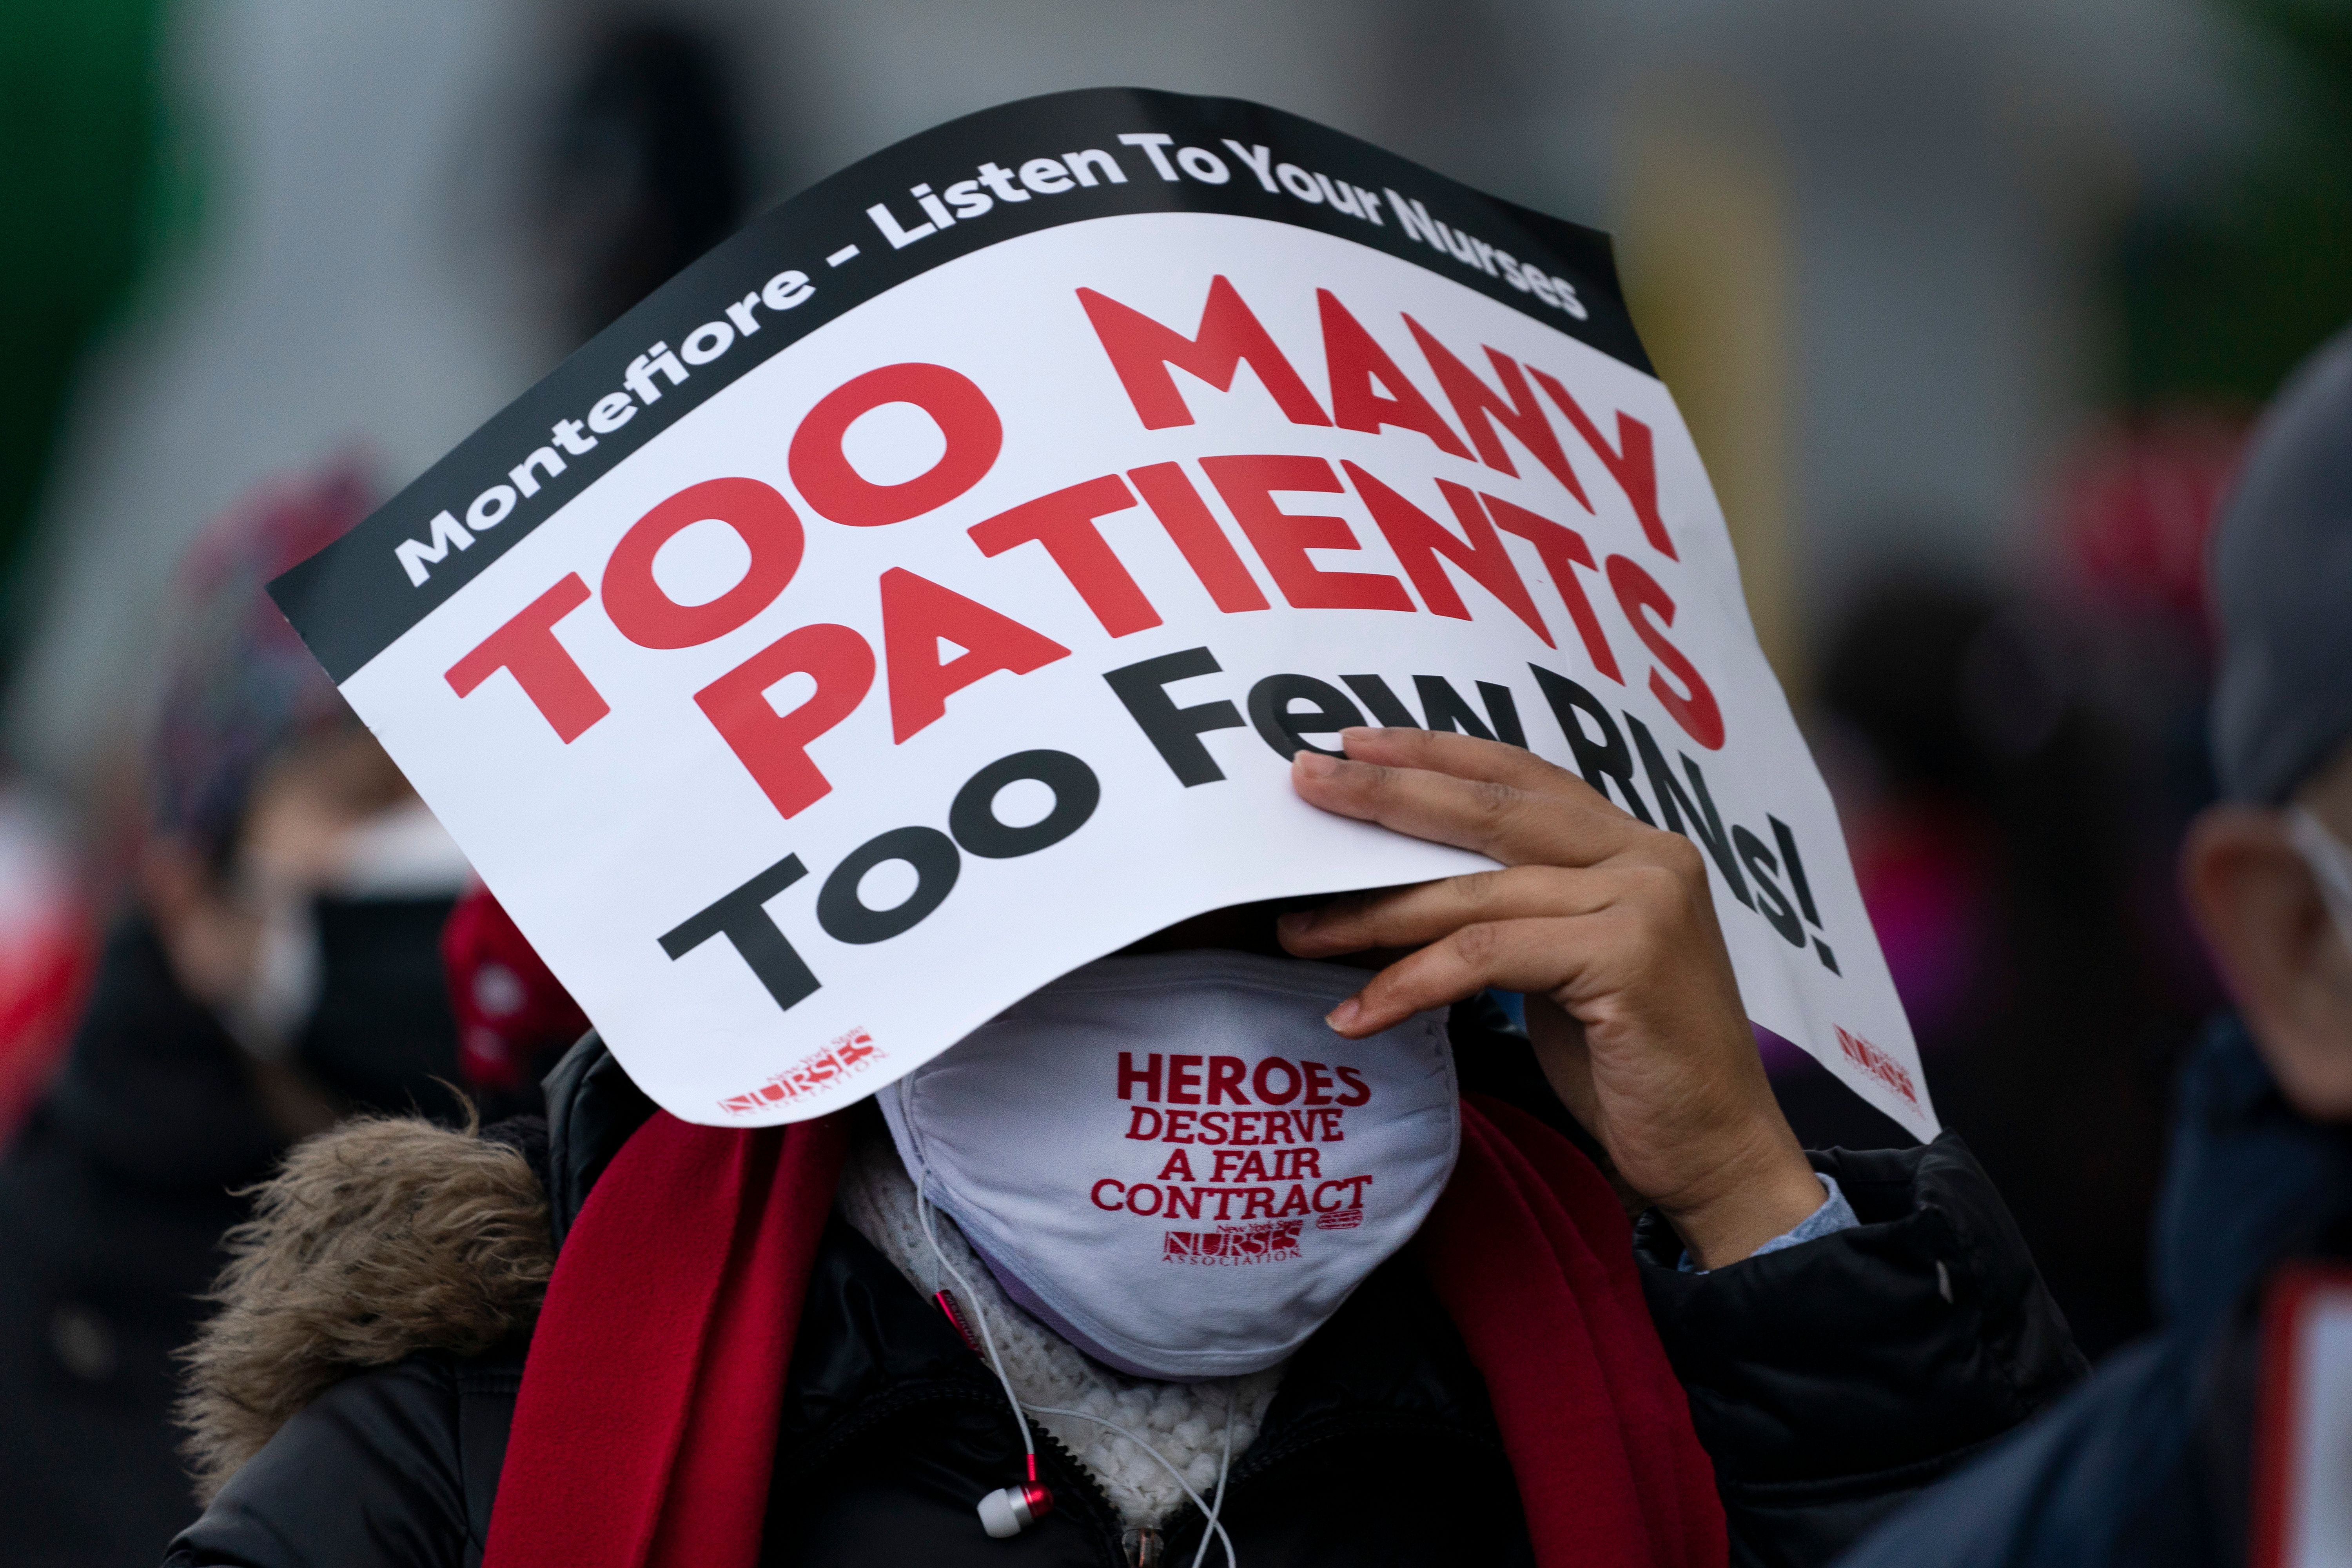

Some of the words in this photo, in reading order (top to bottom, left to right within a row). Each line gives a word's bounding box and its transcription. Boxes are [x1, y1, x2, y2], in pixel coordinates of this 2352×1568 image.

[394, 270, 816, 588] Montefiore
[865, 148, 1129, 250] Listen
[1116, 132, 1231, 184] To
[1221, 137, 1384, 226] Your
[1383, 187, 1589, 320] Nurses
[443, 361, 1004, 745] TOO
[1074, 273, 1680, 563] MANY
[692, 454, 1726, 820] PATIENTS
[657, 748, 1101, 1011] TOO
[716, 1033, 875, 1114] NURSES
[1117, 1052, 1371, 1107] HEROES
[1125, 1105, 1345, 1146] DESERVE
[1157, 1148, 1196, 1182] A
[1209, 1147, 1322, 1183] FAIR
[1090, 1174, 1373, 1221] CONTRACT
[1163, 1222, 1303, 1257] NURSES
[1217, 1224, 1247, 1234] New
[1248, 1221, 1277, 1233] York
[1161, 1247, 1303, 1267] ASSOCIATION
